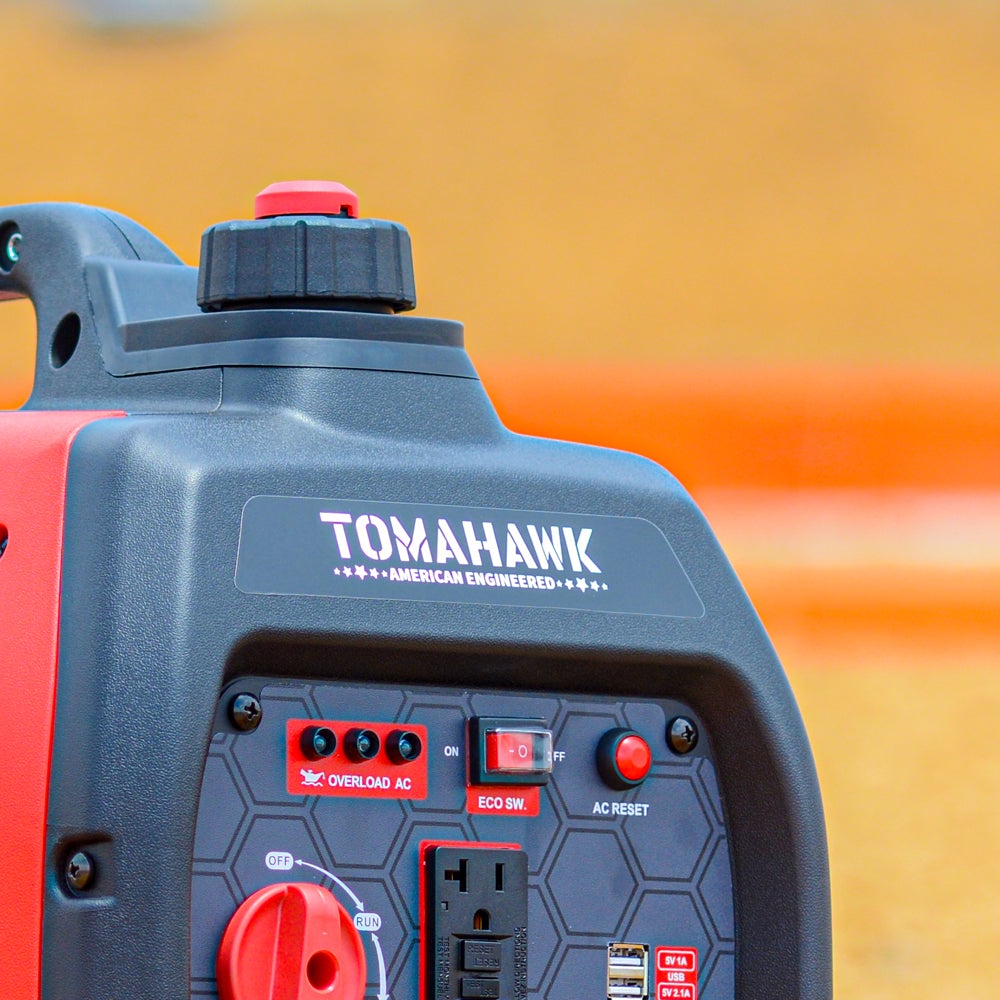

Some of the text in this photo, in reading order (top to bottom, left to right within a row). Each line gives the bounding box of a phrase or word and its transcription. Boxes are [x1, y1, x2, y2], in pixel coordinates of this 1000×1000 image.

[319, 512, 602, 574] TOMAHAWK
[389, 567, 556, 591] AMERICAN ENGINEERED
[444, 746, 459, 757] ON
[328, 774, 412, 791] OVERLOAD AC
[478, 796, 527, 811] ECO SW.
[593, 802, 650, 816] AC RESET
[268, 854, 291, 867] OFF
[356, 916, 380, 928] RUN
[665, 956, 687, 966] 5V 1A
[667, 972, 685, 981] USB
[662, 988, 690, 998] 5V 2.1A
